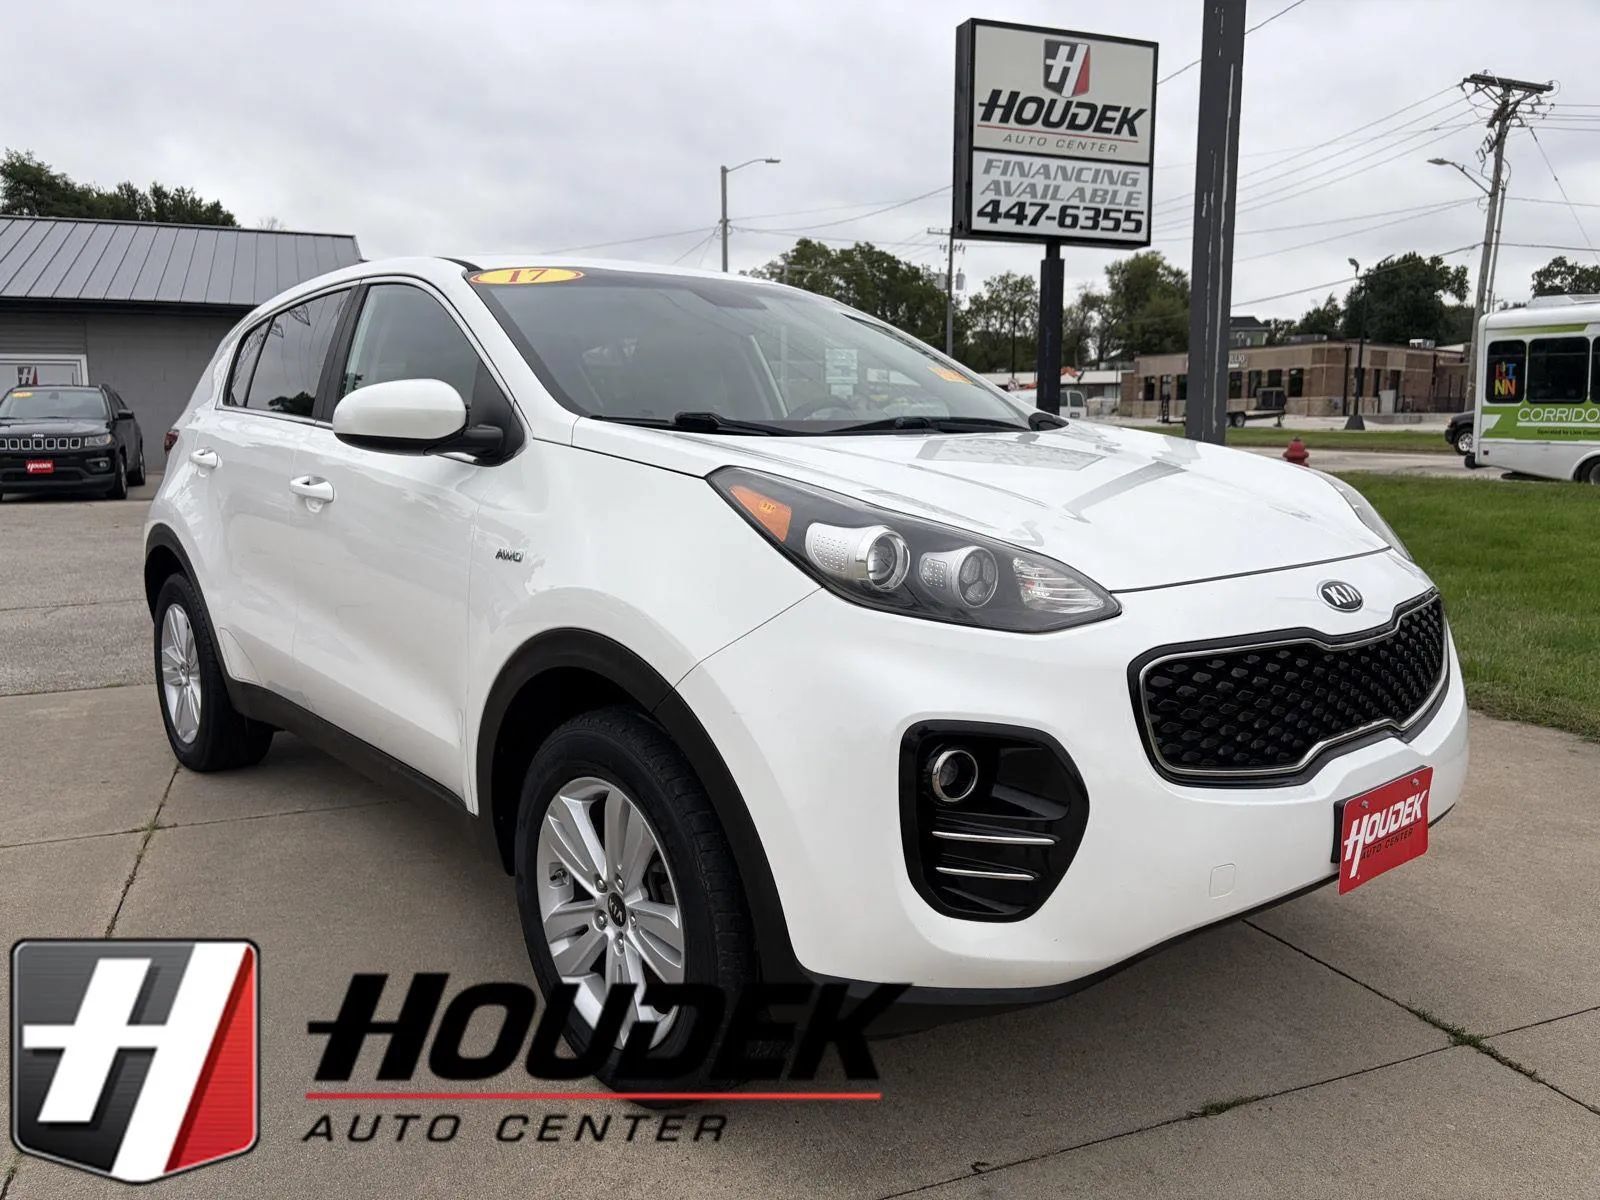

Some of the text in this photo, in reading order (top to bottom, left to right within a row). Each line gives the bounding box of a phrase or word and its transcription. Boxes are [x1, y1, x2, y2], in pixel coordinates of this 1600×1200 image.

[978, 88, 1148, 138] HOUDEK
[1003, 133, 1119, 153] AUTO CENTER
[982, 158, 1141, 188] FINANCING
[980, 179, 1142, 208] AVAILABLE
[976, 199, 1145, 234] 447-6355
[508, 269, 549, 282] 17
[1517, 407, 1600, 422] CORRIDO
[1343, 789, 1428, 880] HOUDEK
[1361, 827, 1414, 859] AUTO CENTER
